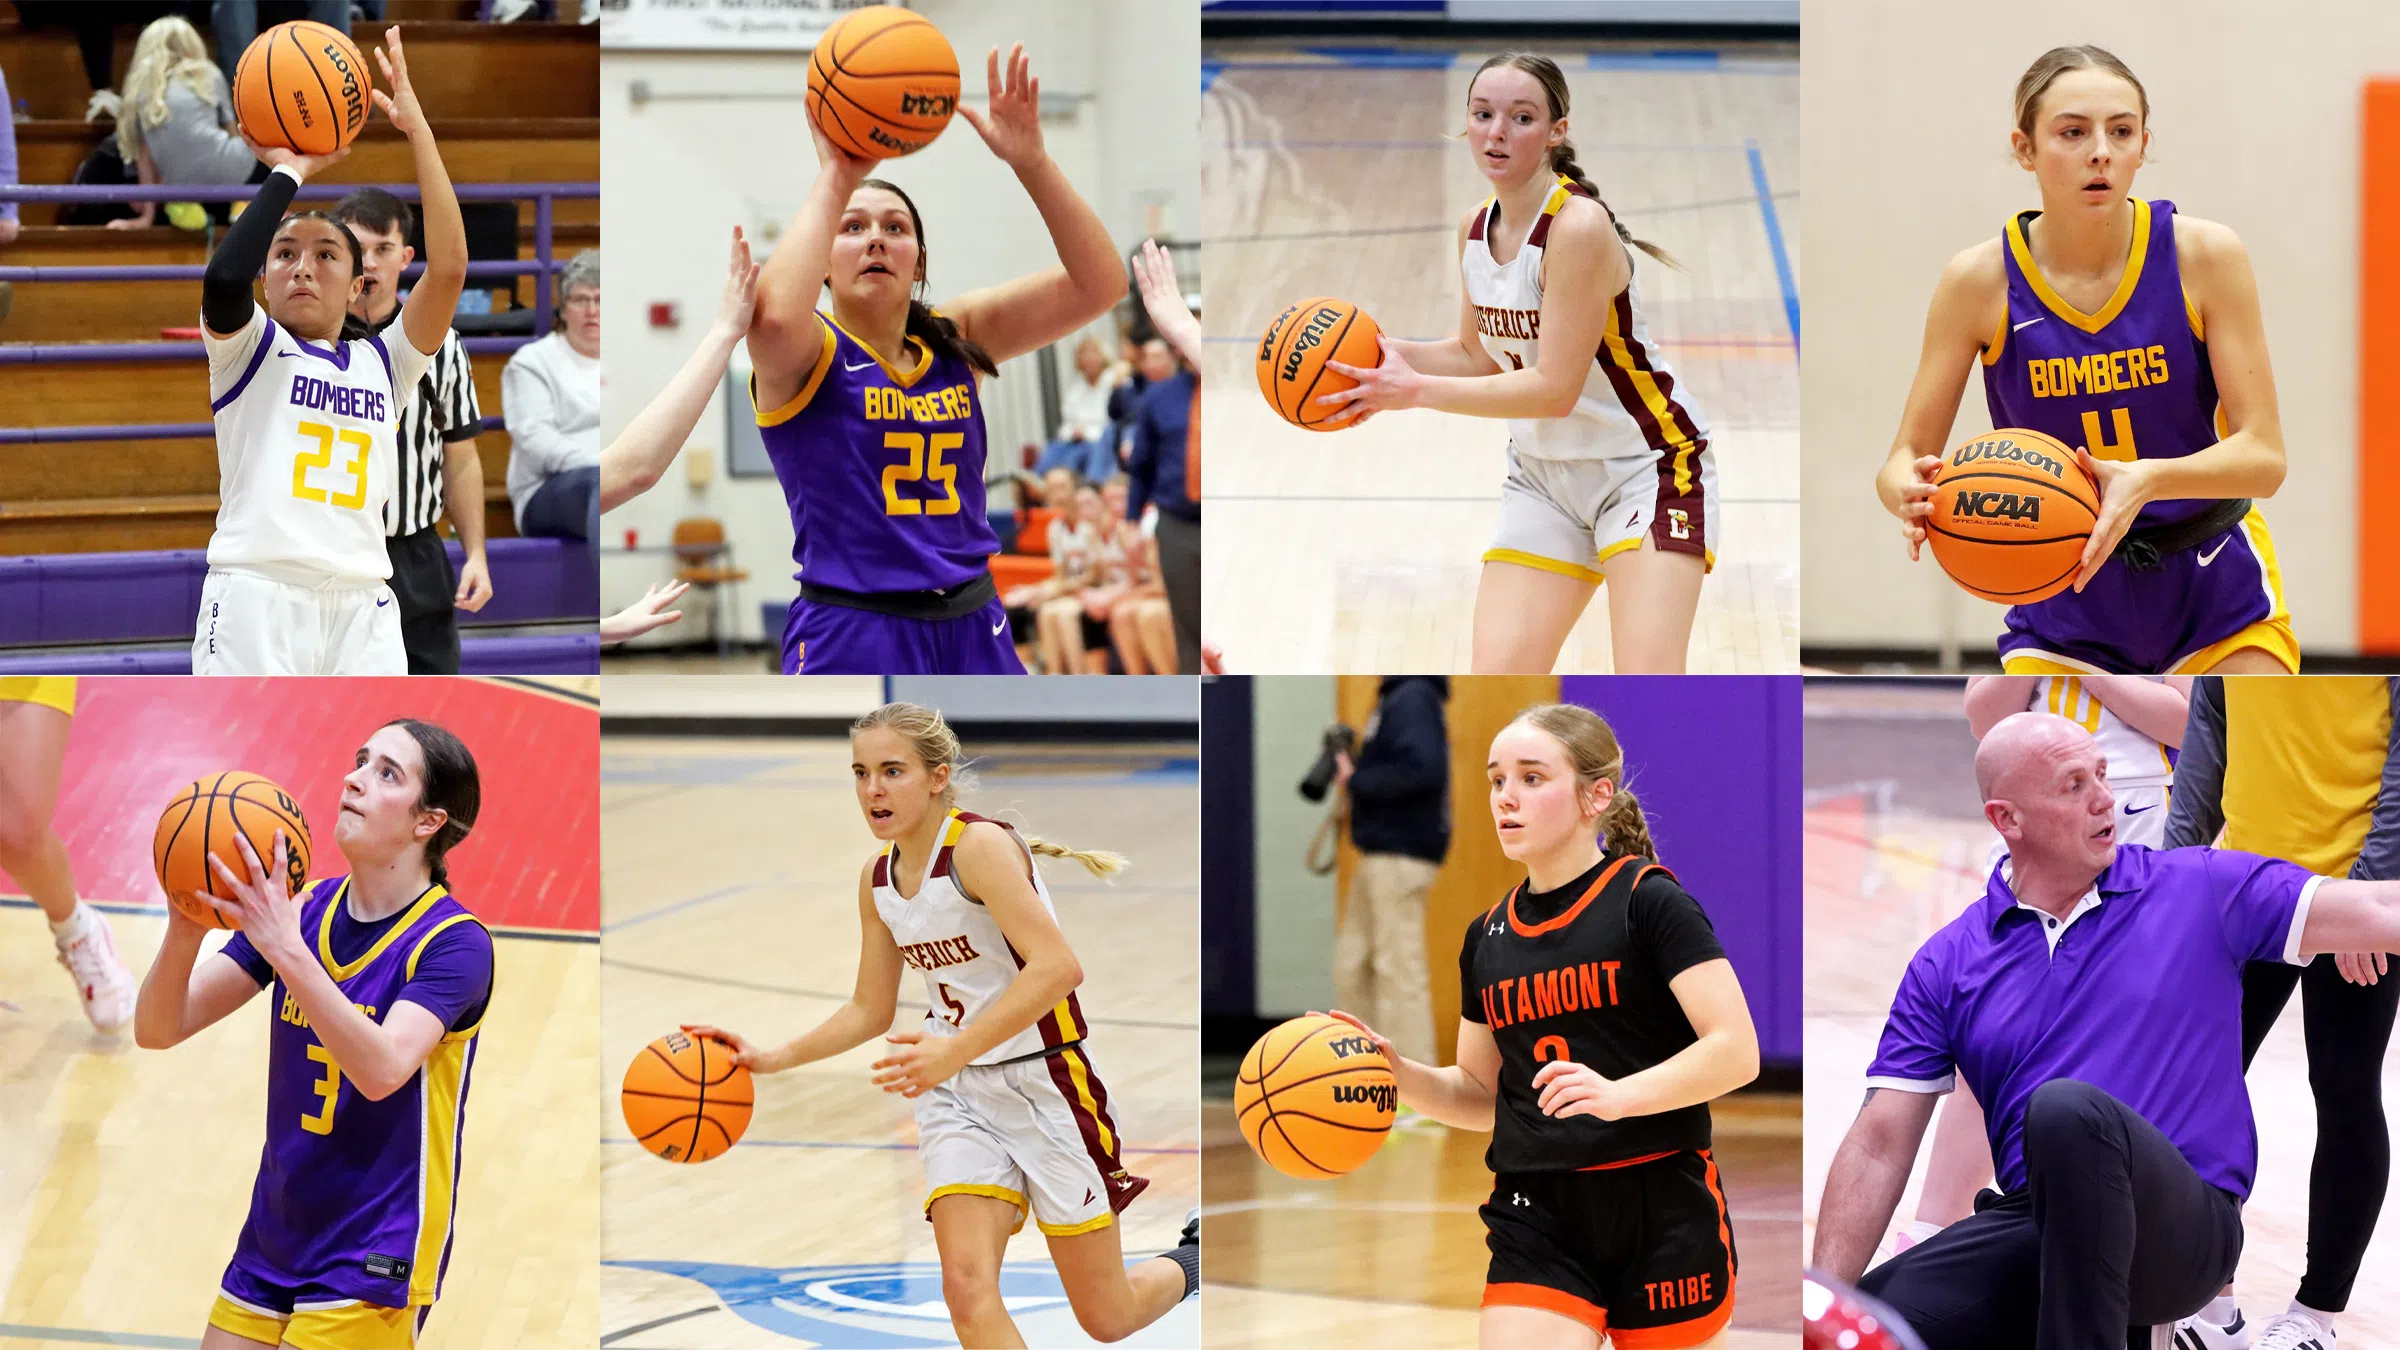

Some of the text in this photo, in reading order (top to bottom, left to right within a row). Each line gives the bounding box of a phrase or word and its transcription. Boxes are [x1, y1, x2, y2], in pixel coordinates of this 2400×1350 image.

[323, 43, 363, 134] Wilson
[1282, 307, 1343, 382] Wilson
[2028, 344, 2170, 399] BOMBERS
[290, 375, 386, 423] BOMBERS
[864, 383, 972, 423] BOMBERS
[292, 420, 373, 511] 23
[881, 431, 965, 516] 25
[1952, 439, 2064, 480] Wilson
[1952, 490, 2040, 523] NCAA
[1952, 518, 2038, 530] OFFICIAL GAME BALL
[209, 602, 219, 655] BSE
[938, 982, 965, 1028] 5
[301, 1043, 341, 1136] 3
[396, 1265, 406, 1275] M
[1644, 1272, 1713, 1311] TRIBE
